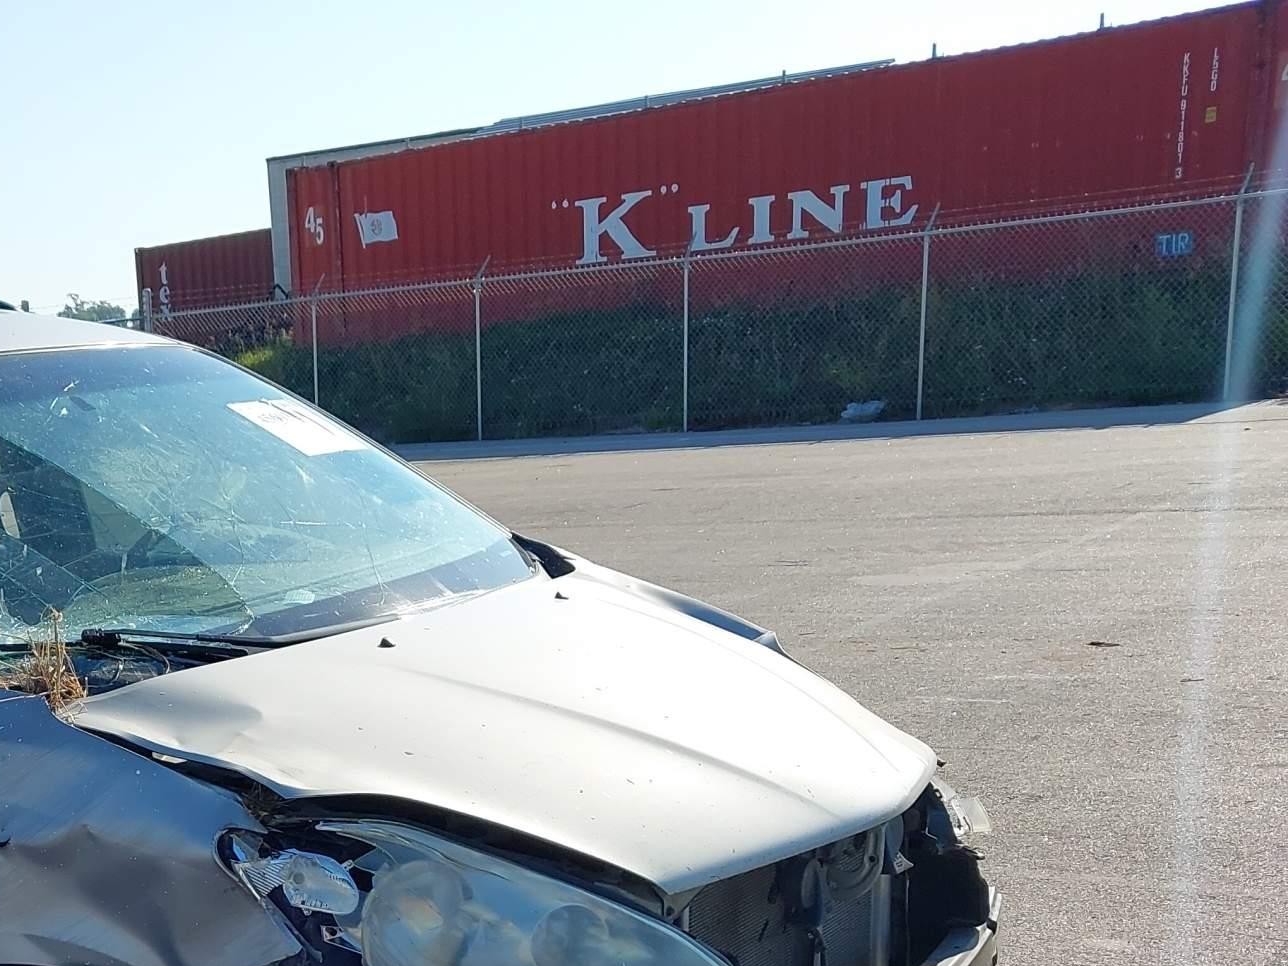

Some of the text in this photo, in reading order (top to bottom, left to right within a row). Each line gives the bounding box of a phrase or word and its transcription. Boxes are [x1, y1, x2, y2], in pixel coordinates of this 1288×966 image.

[304, 207, 324, 245] 45
[687, 176, 919, 251] LINE
[1160, 233, 1189, 254] TIR
